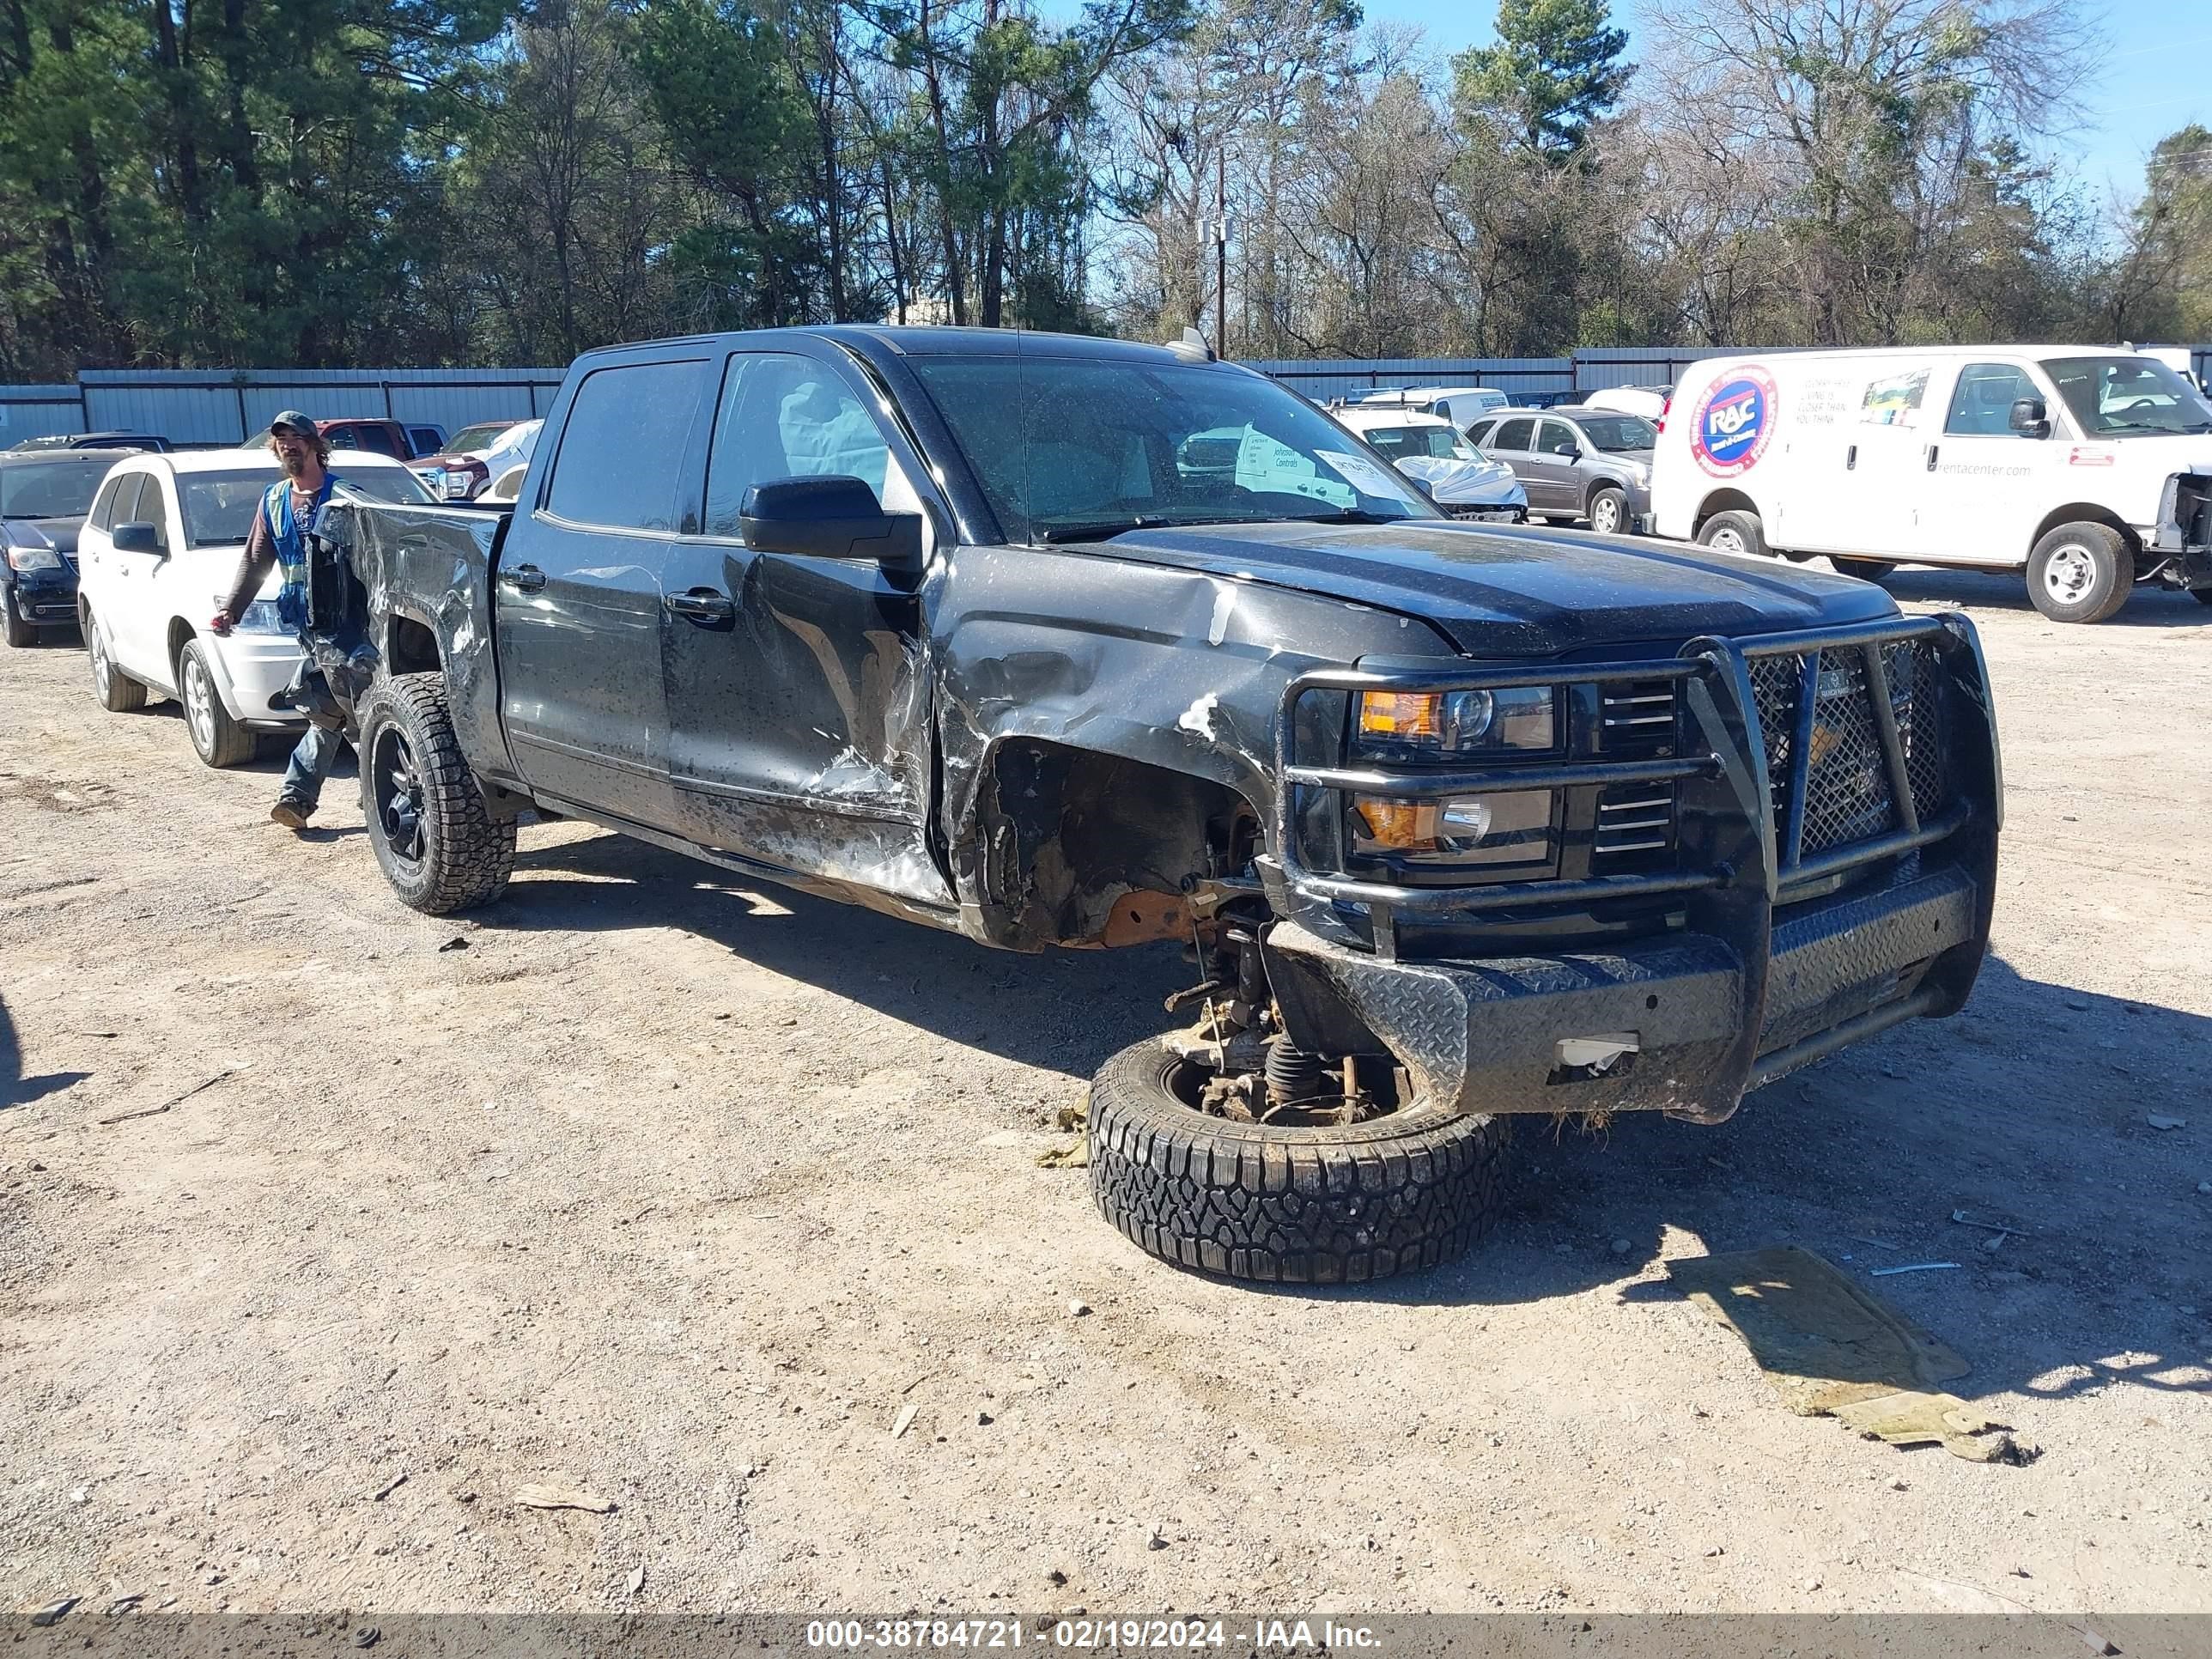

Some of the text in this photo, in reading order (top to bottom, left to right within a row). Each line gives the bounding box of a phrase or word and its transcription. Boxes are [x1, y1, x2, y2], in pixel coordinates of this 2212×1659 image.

[1710, 398, 1755, 434] RAC
[1275, 458, 1298, 468] Controls
[1938, 463, 2031, 477] rentacenter.com
